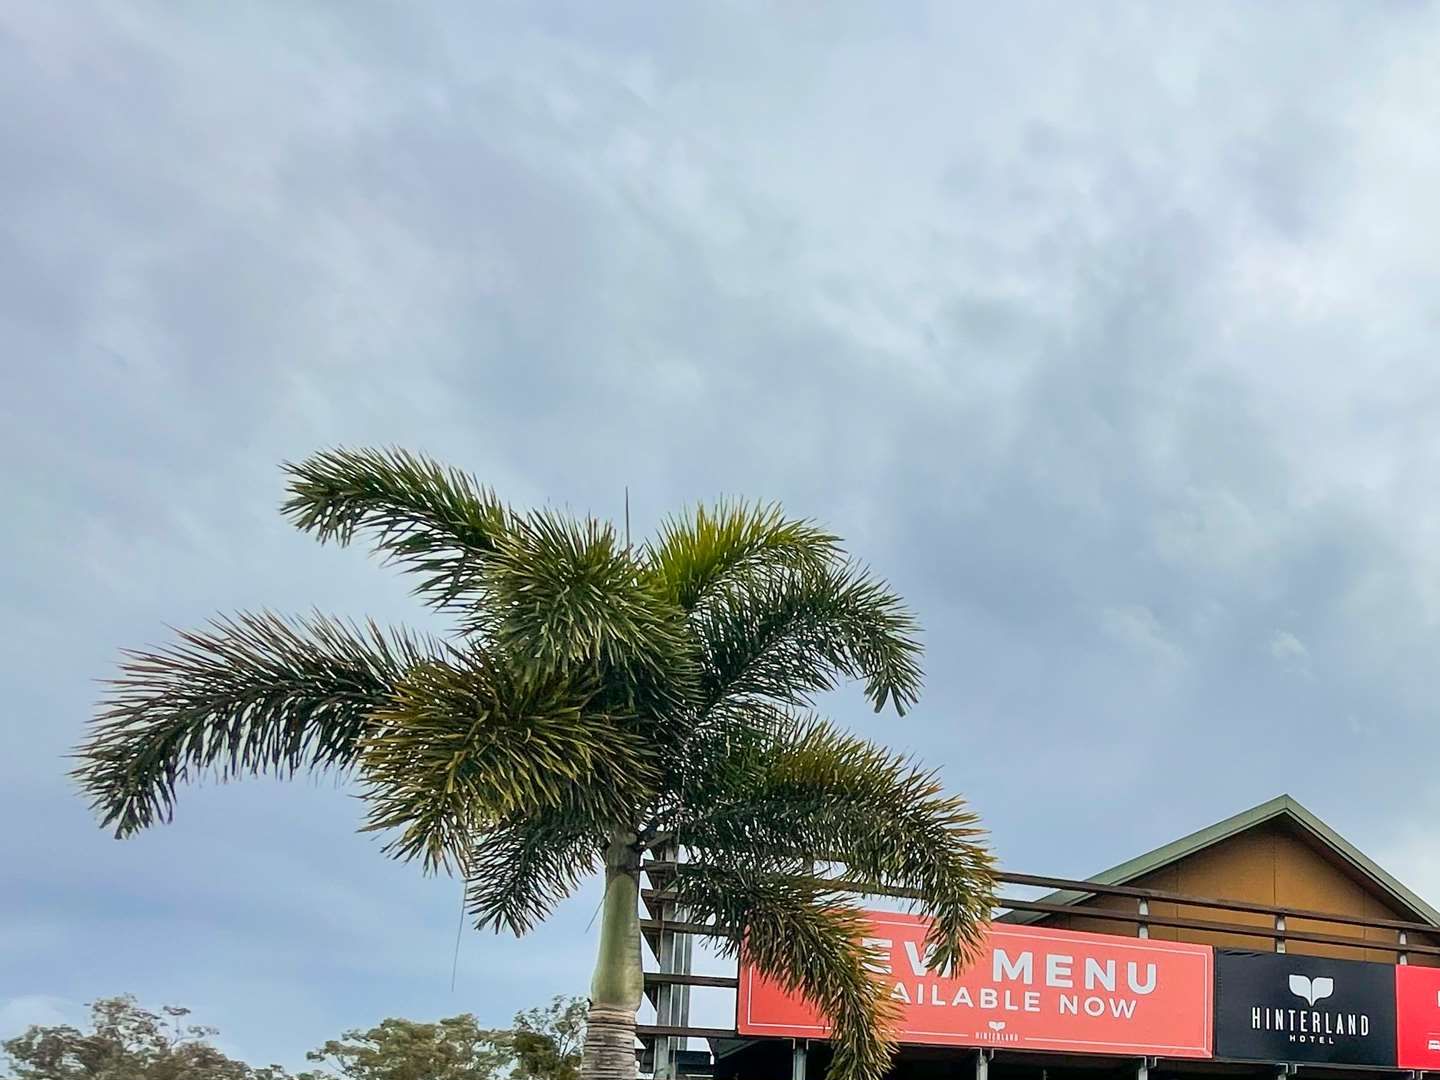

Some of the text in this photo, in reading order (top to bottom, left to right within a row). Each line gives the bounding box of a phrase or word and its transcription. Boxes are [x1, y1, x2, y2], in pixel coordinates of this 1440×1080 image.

[993, 949, 1158, 995] MENU
[889, 981, 1138, 1020] AILABLE NOW
[1251, 1006, 1370, 1037] HINTERLAND
[1289, 1034, 1334, 1045] HOTEL
